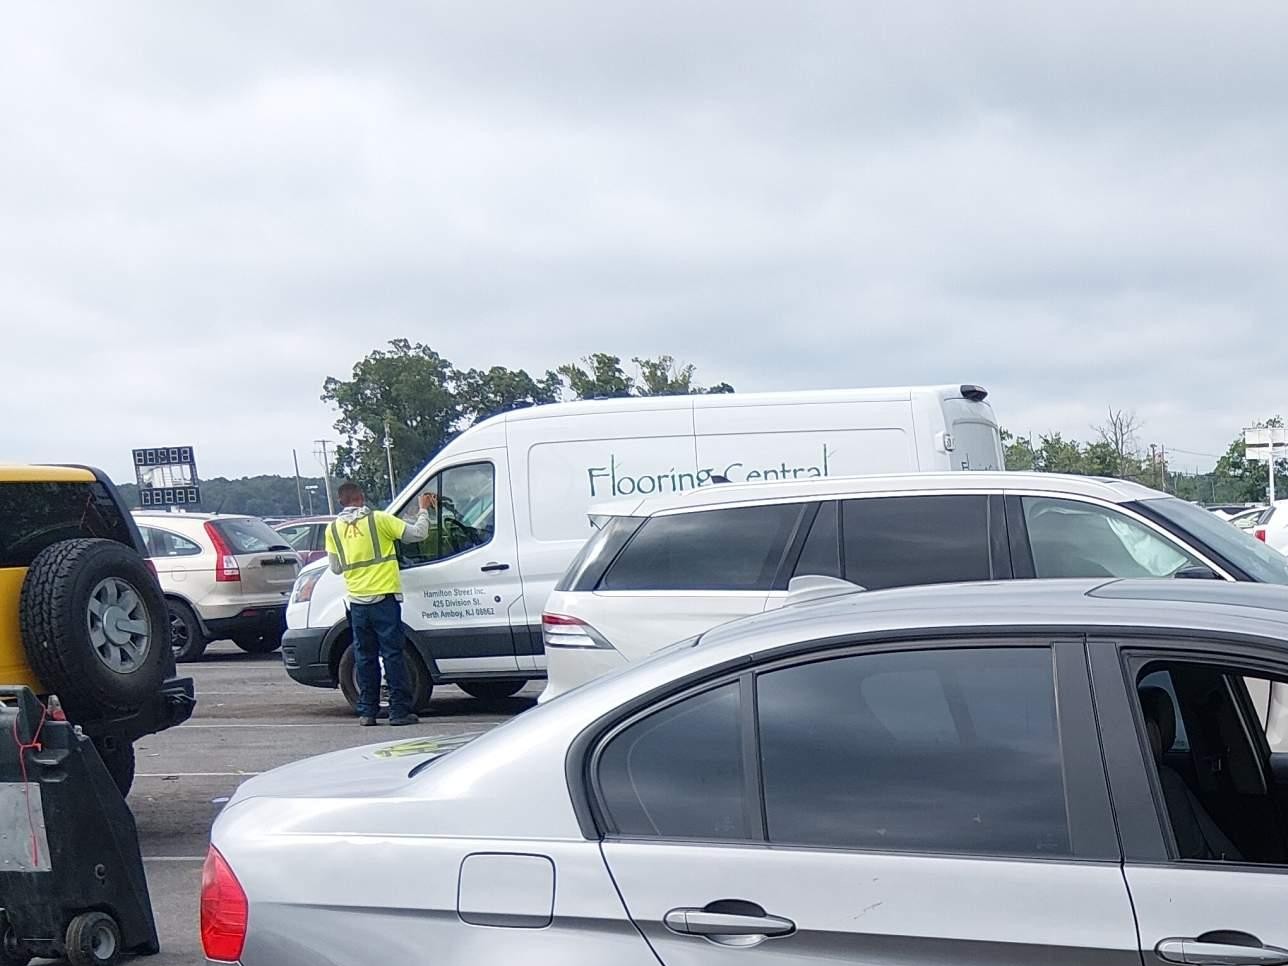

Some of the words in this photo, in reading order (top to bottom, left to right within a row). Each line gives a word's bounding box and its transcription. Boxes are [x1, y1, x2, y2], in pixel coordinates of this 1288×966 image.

[587, 454, 714, 497] Flooring
[424, 590, 452, 598] Hamilton
[453, 588, 472, 596] Street
[432, 600, 444, 608] 425
[445, 598, 471, 607] Division
[422, 611, 439, 619] Perth
